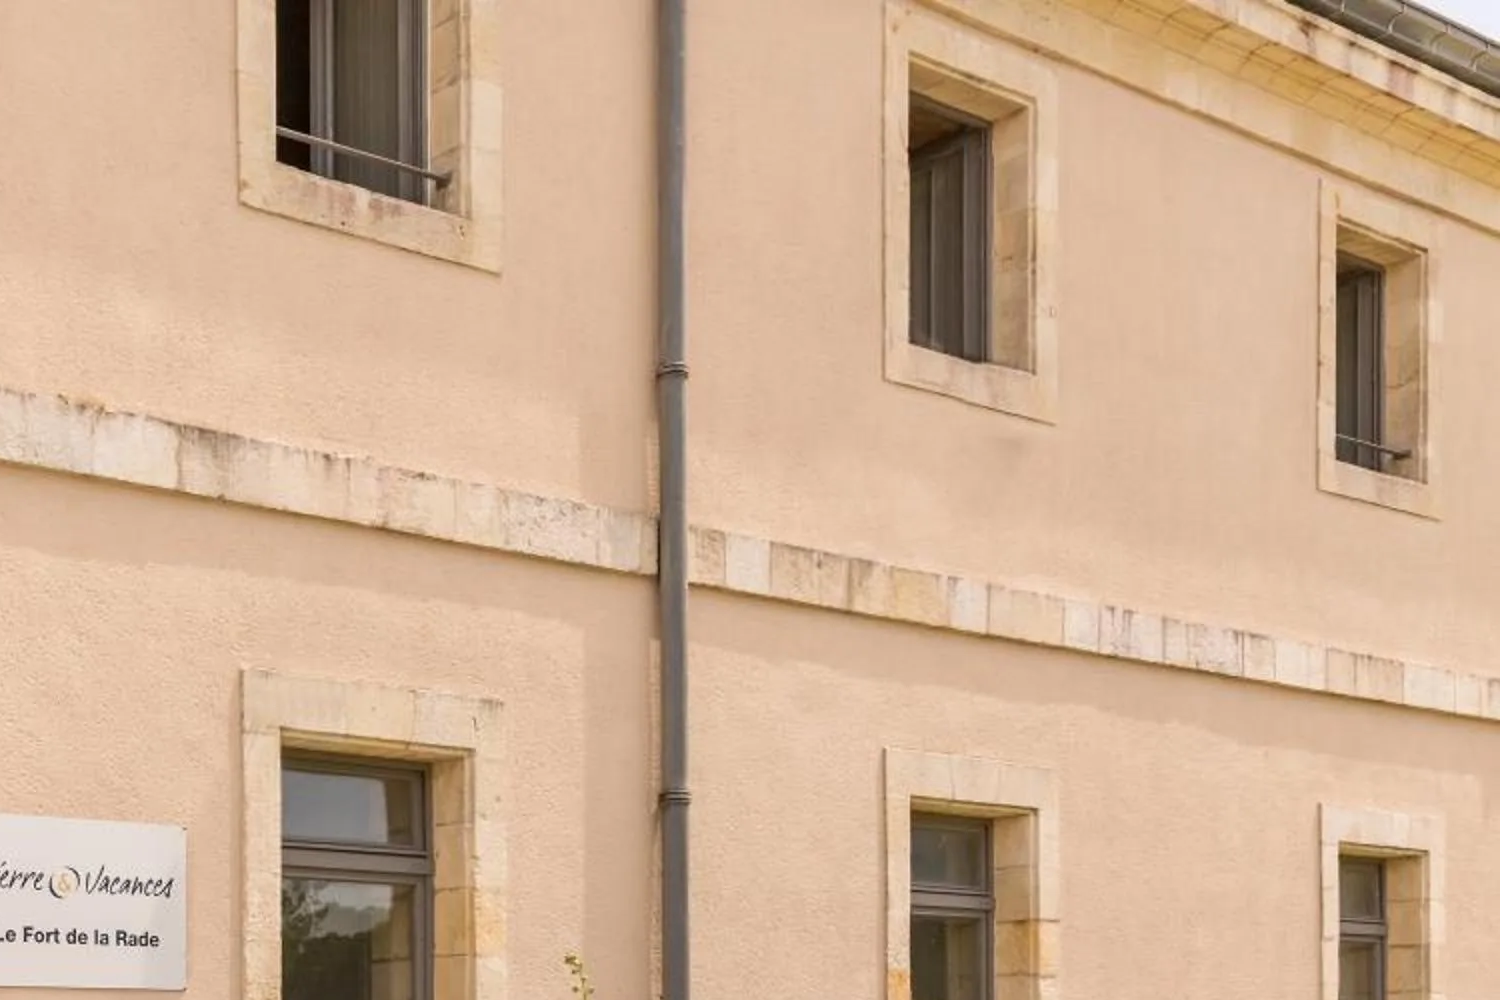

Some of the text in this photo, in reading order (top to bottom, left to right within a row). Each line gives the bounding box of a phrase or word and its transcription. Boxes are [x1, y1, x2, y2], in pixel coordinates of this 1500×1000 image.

[85, 864, 175, 899] Vacances
[22, 925, 61, 945] Fort
[66, 927, 89, 946] de
[94, 929, 110, 946] la
[115, 929, 160, 948] Rade
